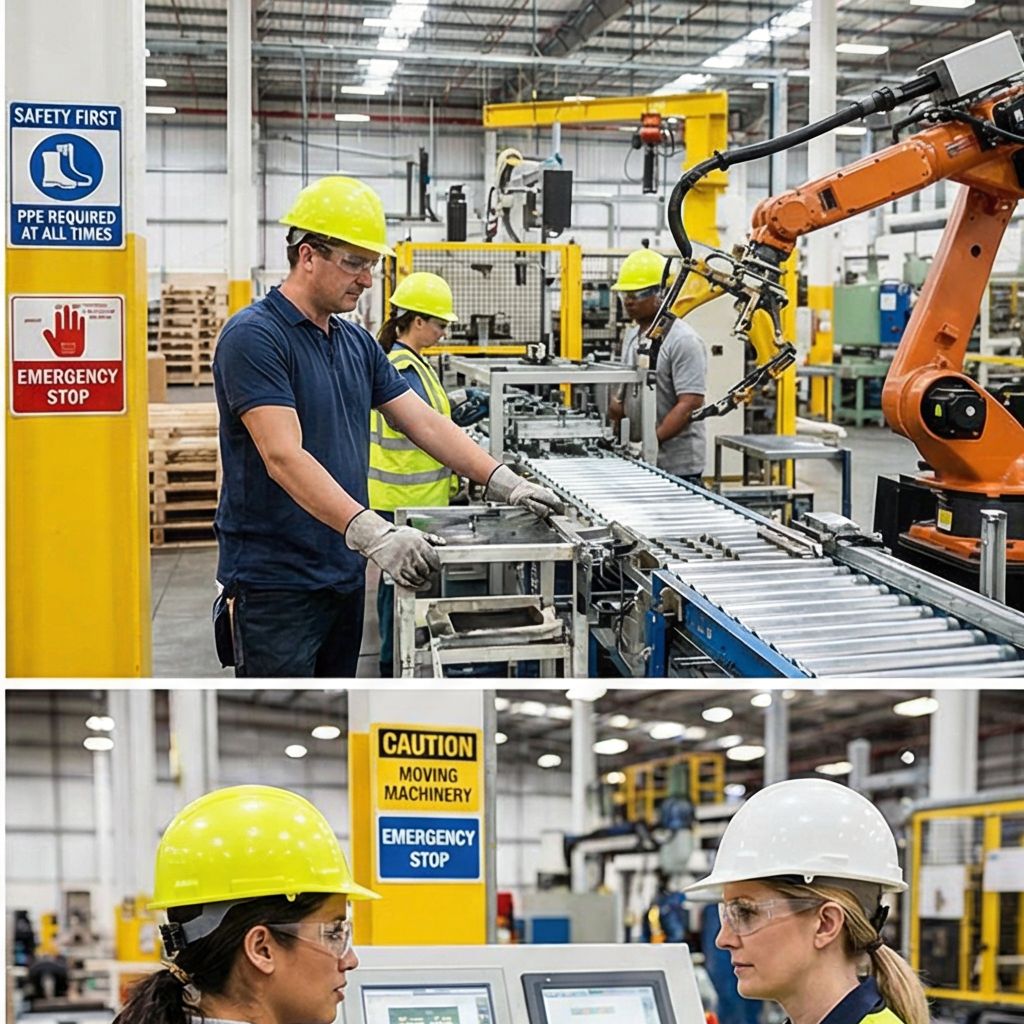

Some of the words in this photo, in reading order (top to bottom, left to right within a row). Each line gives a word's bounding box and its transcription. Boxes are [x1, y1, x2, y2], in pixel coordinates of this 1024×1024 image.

[14, 107, 71, 125] SAFETY
[75, 109, 117, 126] FIRST
[17, 209, 44, 223] PPE
[48, 210, 116, 226] REQUIRED
[21, 226, 39, 240] AT
[41, 226, 67, 240] ALL
[70, 227, 112, 241] TIMES
[17, 368, 119, 385] EMERGENCY
[47, 389, 90, 405] STOP
[382, 731, 473, 758] CAUTION
[399, 766, 458, 783] MOVING
[384, 785, 472, 803] MACHINERY
[382, 828, 476, 846] EMERGENCY
[409, 851, 450, 868] STOP
